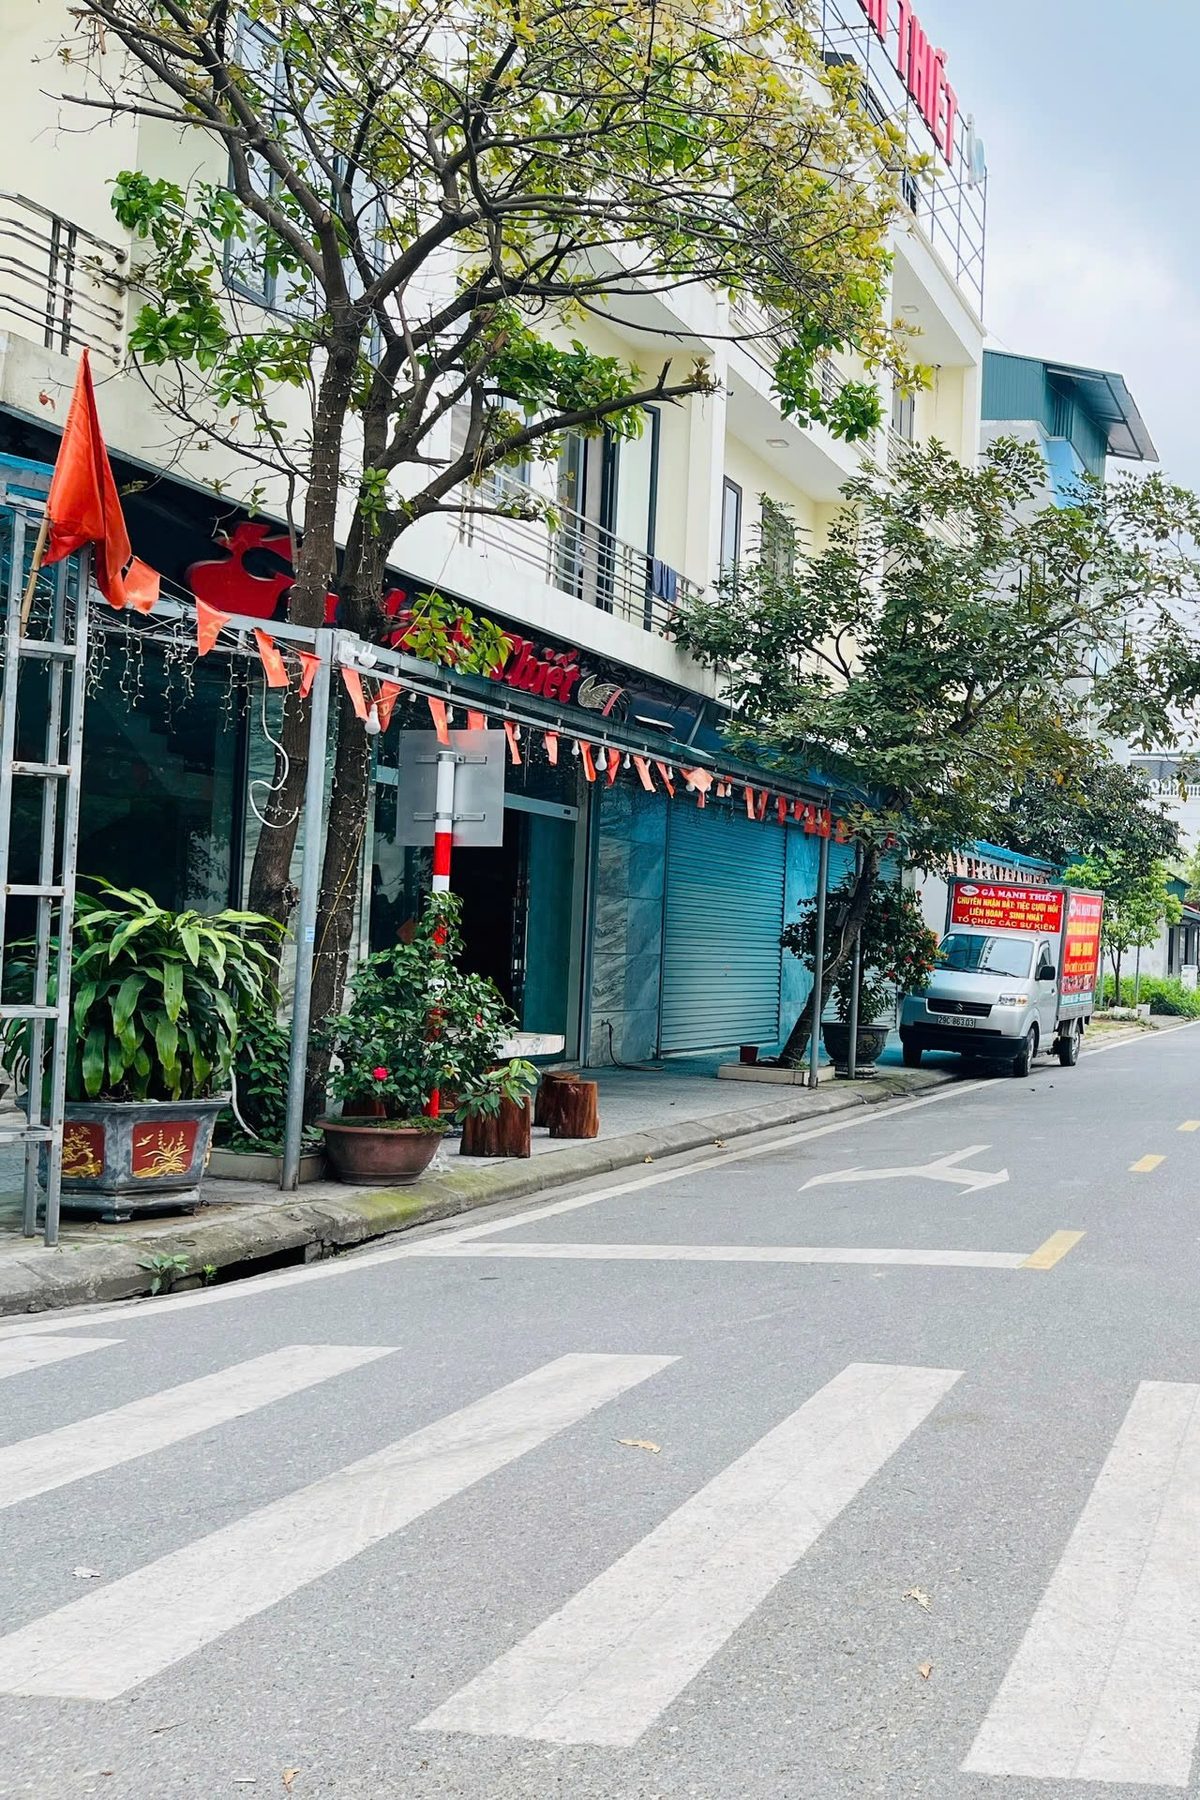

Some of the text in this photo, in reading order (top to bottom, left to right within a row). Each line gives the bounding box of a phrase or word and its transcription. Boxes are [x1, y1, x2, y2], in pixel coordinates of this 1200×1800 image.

[981, 888, 996, 897] GÀ
[998, 890, 1026, 900] MẠNH
[1028, 891, 1058, 902] THIẾT
[957, 896, 982, 906] CHUYÊN
[985, 909, 1004, 919] HOAN
[1009, 911, 1026, 920] SINH
